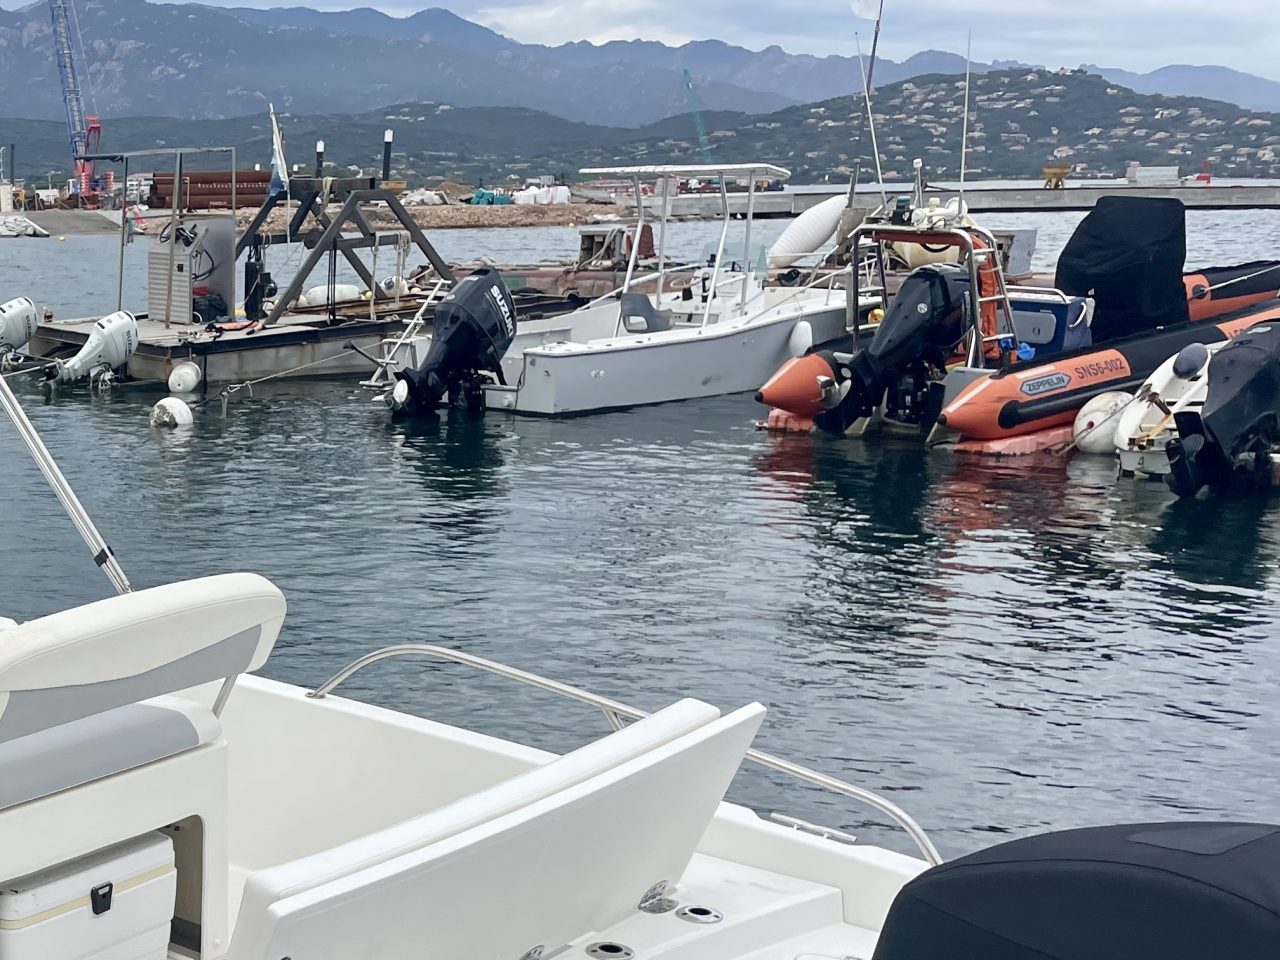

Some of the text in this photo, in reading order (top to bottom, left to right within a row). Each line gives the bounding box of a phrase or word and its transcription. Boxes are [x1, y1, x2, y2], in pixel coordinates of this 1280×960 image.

[490, 285, 514, 338] SUZUKI
[1074, 357, 1126, 379] SNS6-002
[1026, 375, 1066, 392] ZEPPELIN
